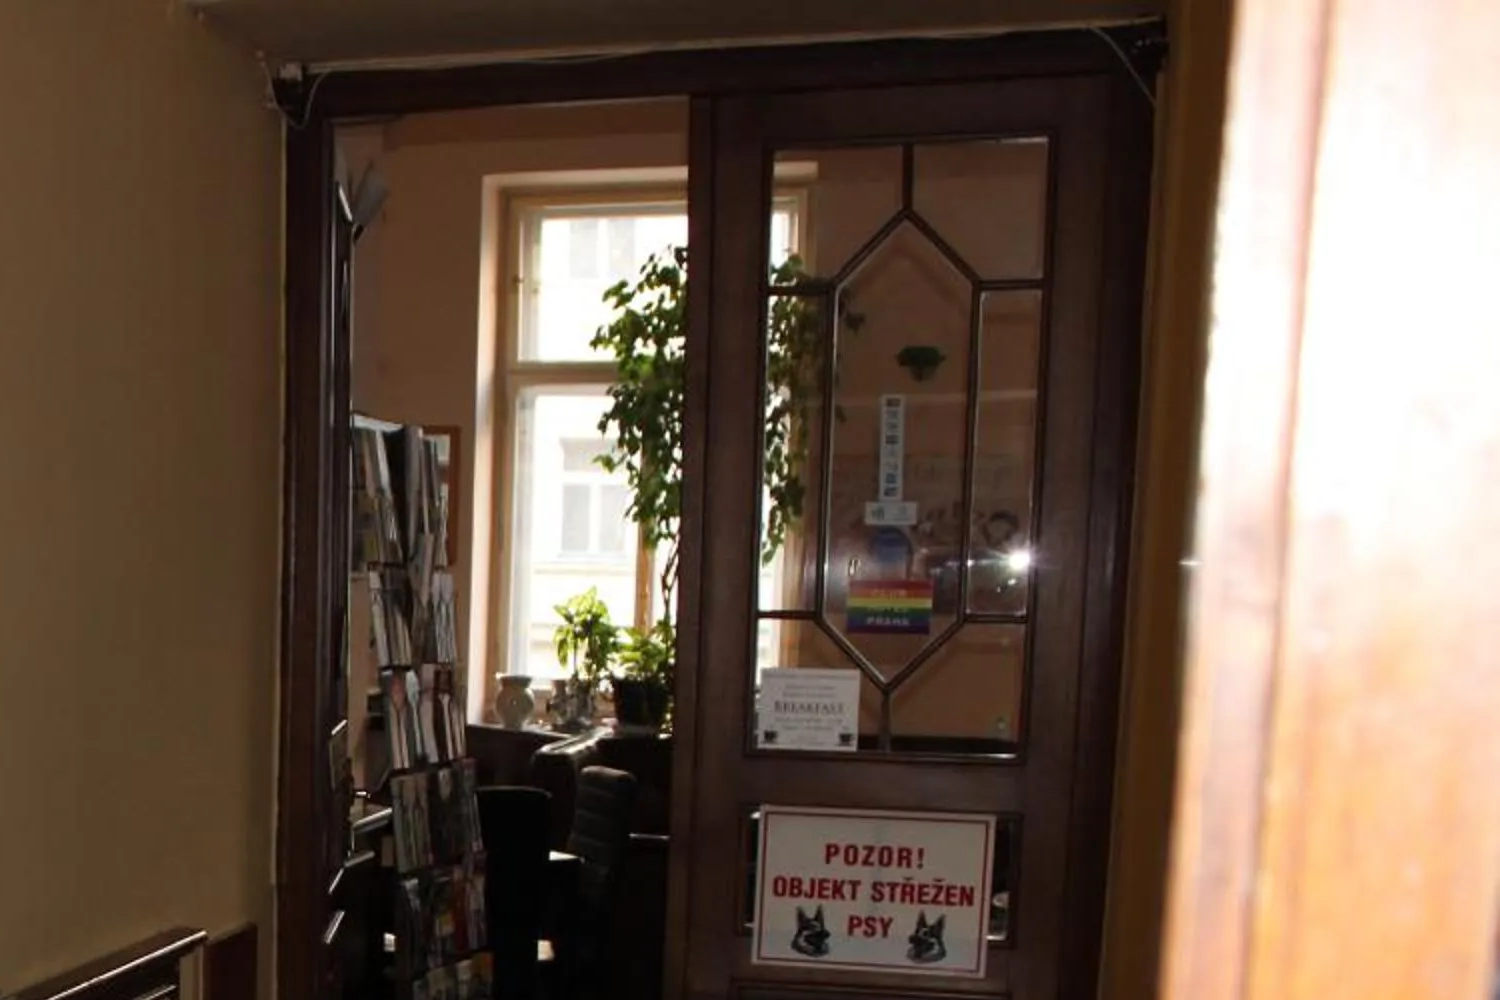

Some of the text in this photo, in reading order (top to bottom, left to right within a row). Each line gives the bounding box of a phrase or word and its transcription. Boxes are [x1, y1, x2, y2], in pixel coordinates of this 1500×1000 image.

[824, 843, 925, 869] POZOR!
[772, 876, 975, 907] OBJEKT STŘEŽEN
[847, 915, 894, 938] PSY
